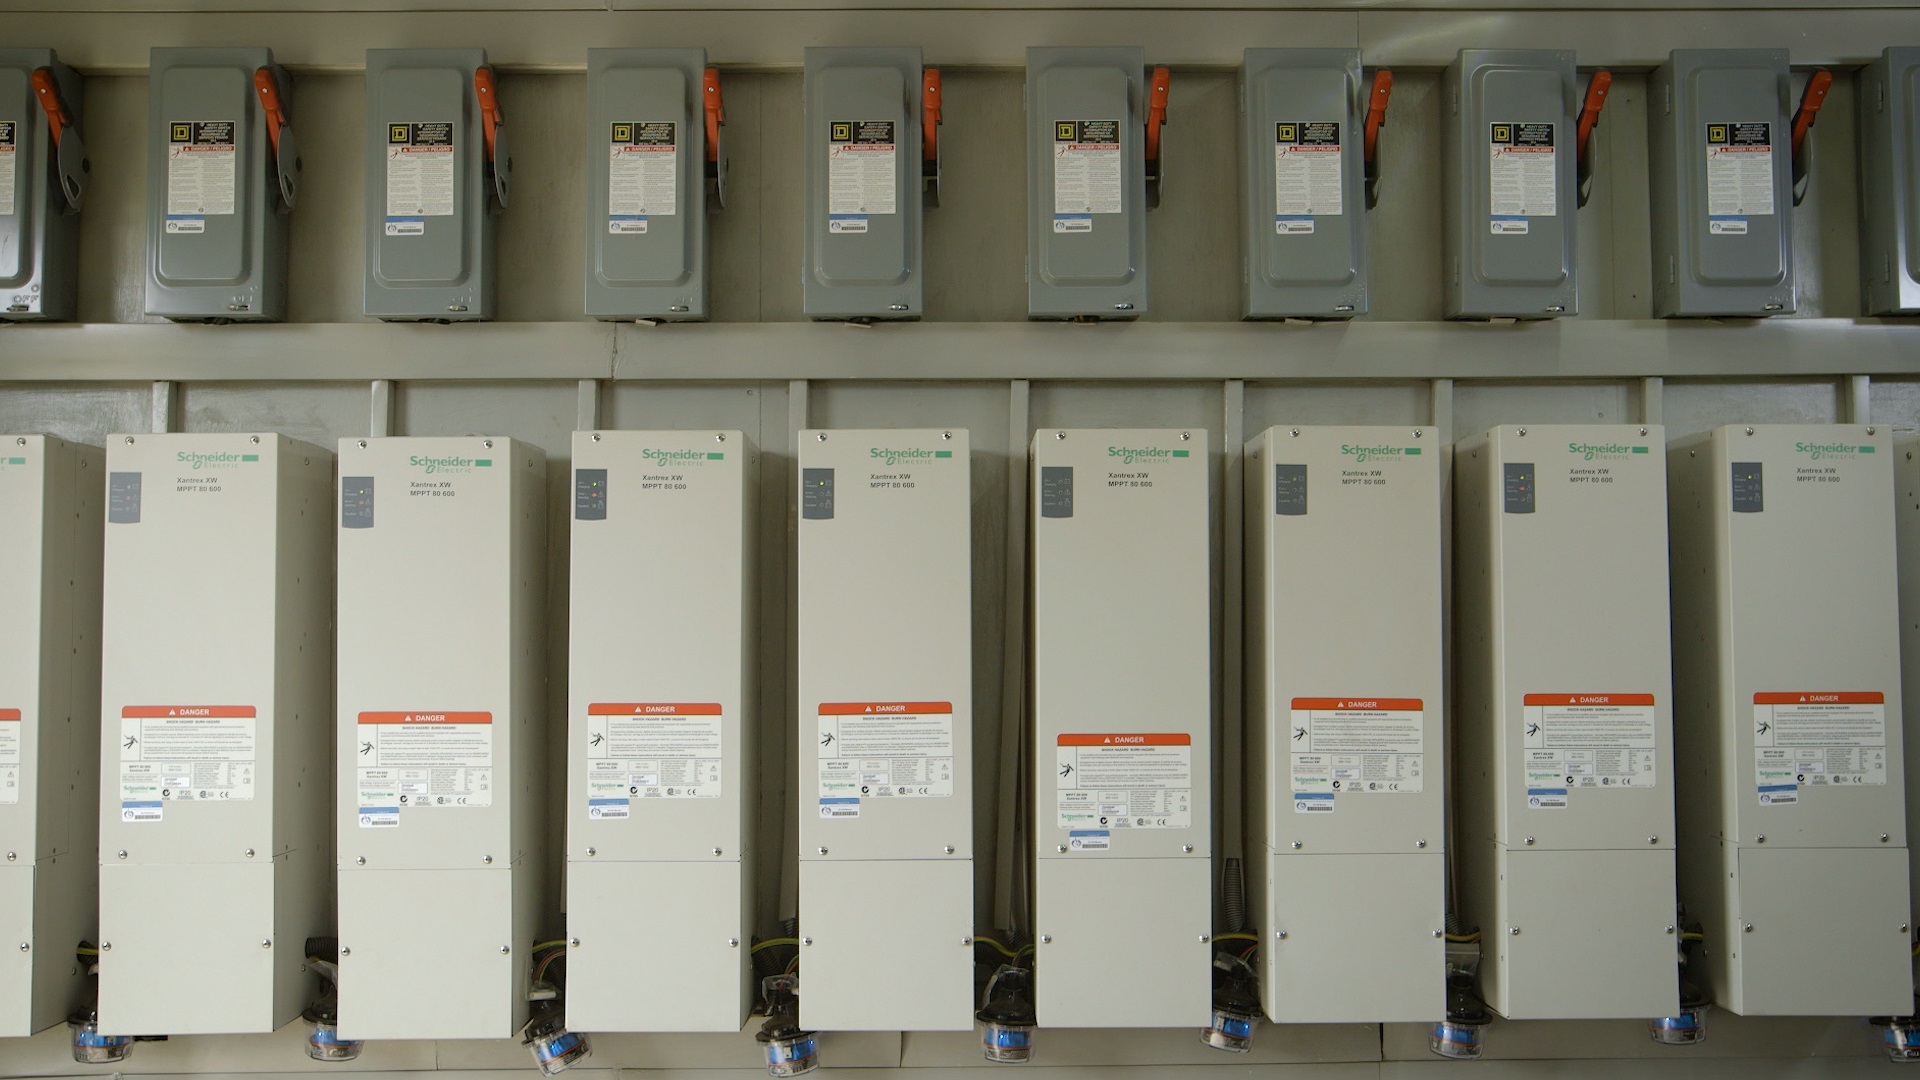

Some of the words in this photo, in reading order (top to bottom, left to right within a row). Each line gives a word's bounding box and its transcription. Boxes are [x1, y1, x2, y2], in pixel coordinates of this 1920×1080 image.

[870, 448, 933, 459] Schneider
[1108, 447, 1170, 458] Schneider
[1341, 445, 1402, 456] Schneider
[1569, 443, 1630, 454] Schneider
[1796, 443, 1856, 454] Schneider
[177, 451, 240, 462] Schneider
[643, 449, 705, 460] Schneider
[410, 456, 472, 467] Schneider
[1108, 480, 1128, 488] MPPT
[1130, 480, 1139, 488] 80
[1140, 480, 1153, 488] 600
[1341, 478, 1362, 486] MPPT
[1364, 478, 1372, 486] 80
[1374, 478, 1386, 486] 600
[1569, 476, 1589, 484] MPPT
[1591, 476, 1599, 484] 80
[1601, 476, 1613, 484] 600
